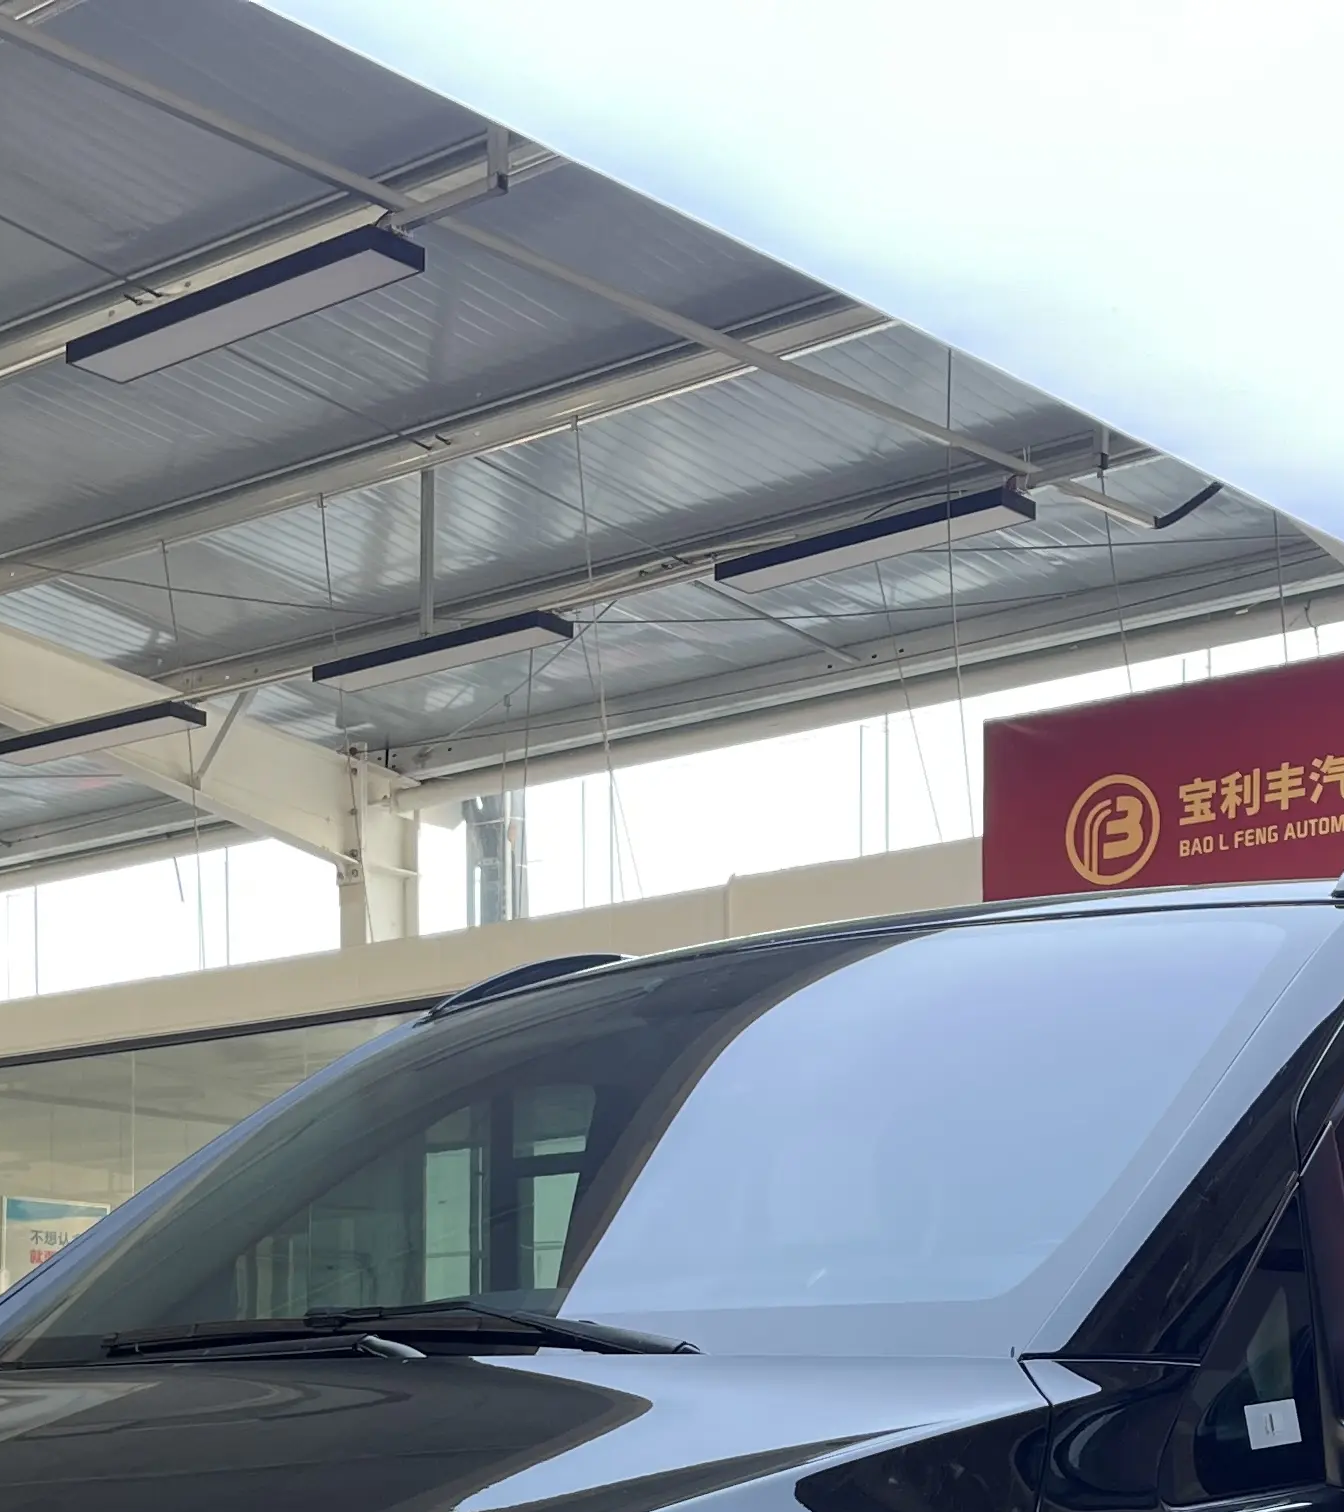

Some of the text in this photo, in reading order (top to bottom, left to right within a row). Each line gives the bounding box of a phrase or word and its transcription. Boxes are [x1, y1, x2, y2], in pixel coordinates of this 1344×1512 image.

[1179, 835, 1214, 857] BAO
[1234, 825, 1279, 849] FENG
[30, 1229, 80, 1246] 不想认
